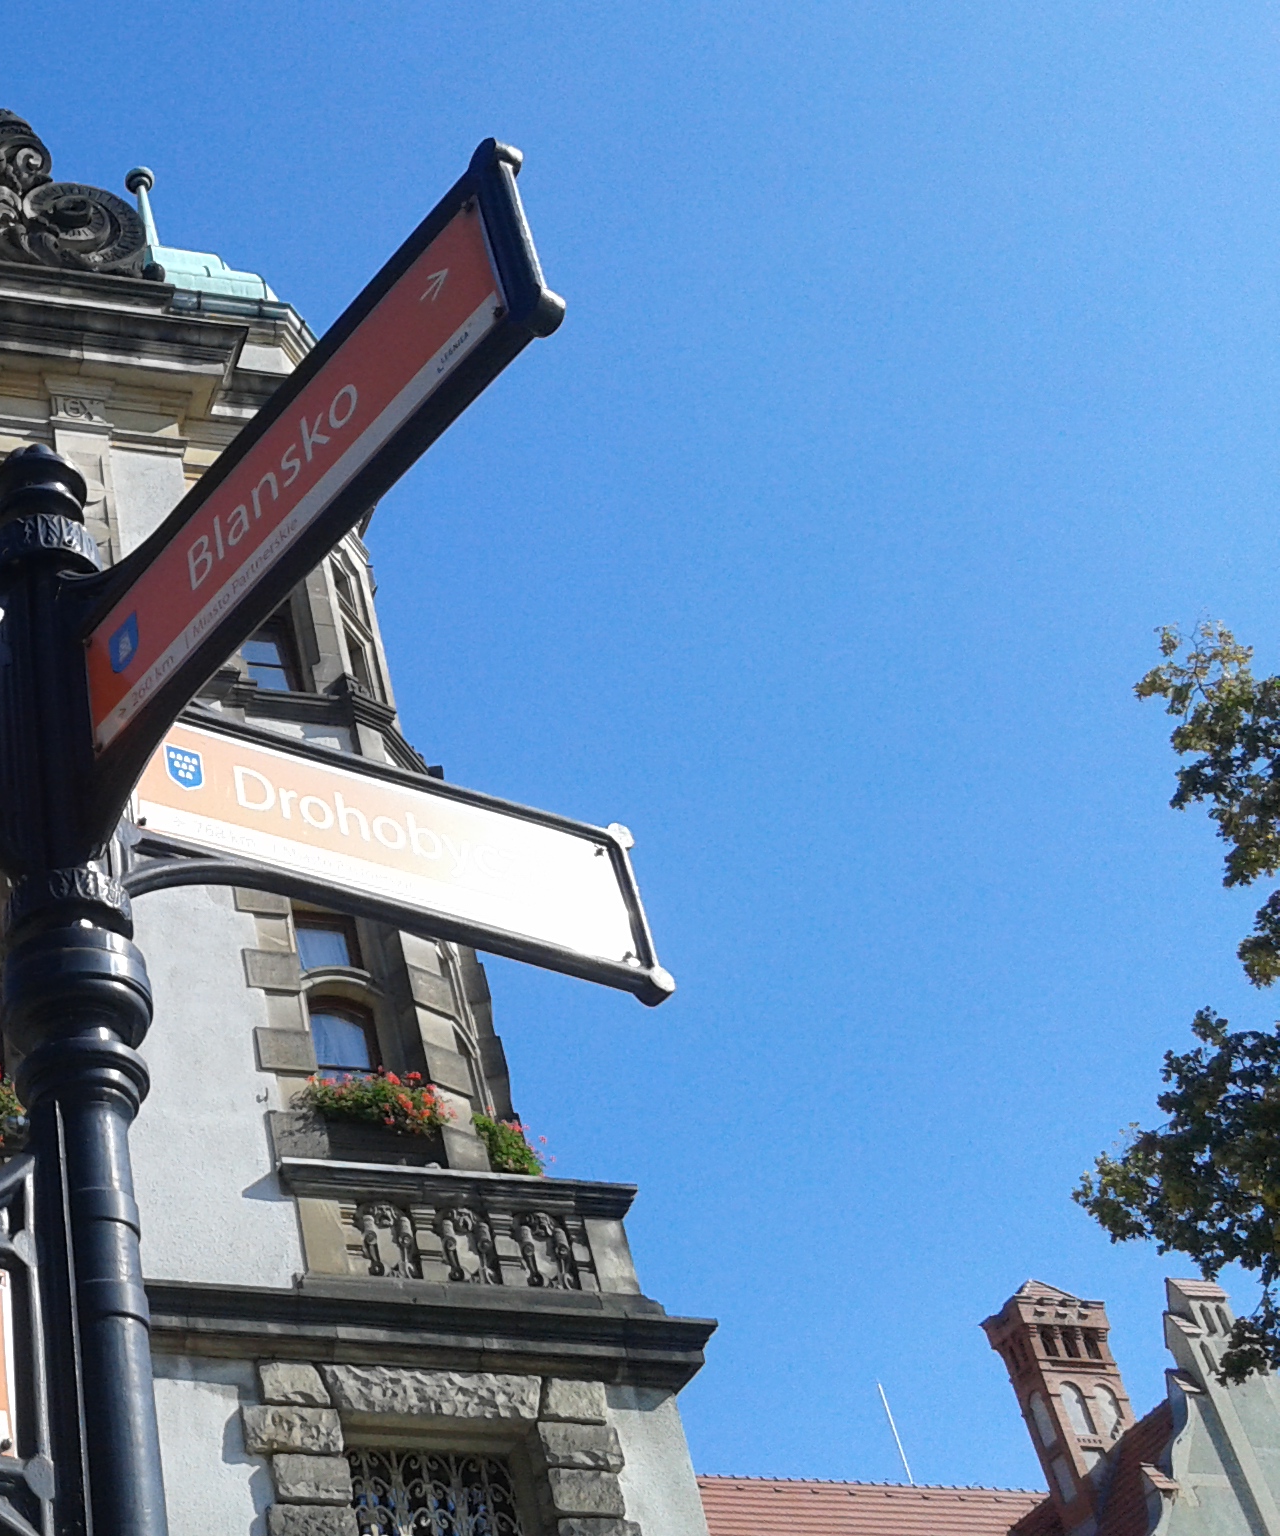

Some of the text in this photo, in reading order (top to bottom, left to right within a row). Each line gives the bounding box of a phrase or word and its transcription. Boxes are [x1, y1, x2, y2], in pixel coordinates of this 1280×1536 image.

[185, 383, 359, 592] Blansko
[153, 655, 175, 679] km
[192, 592, 230, 637] Miasto
[231, 518, 298, 594] Partnerskie
